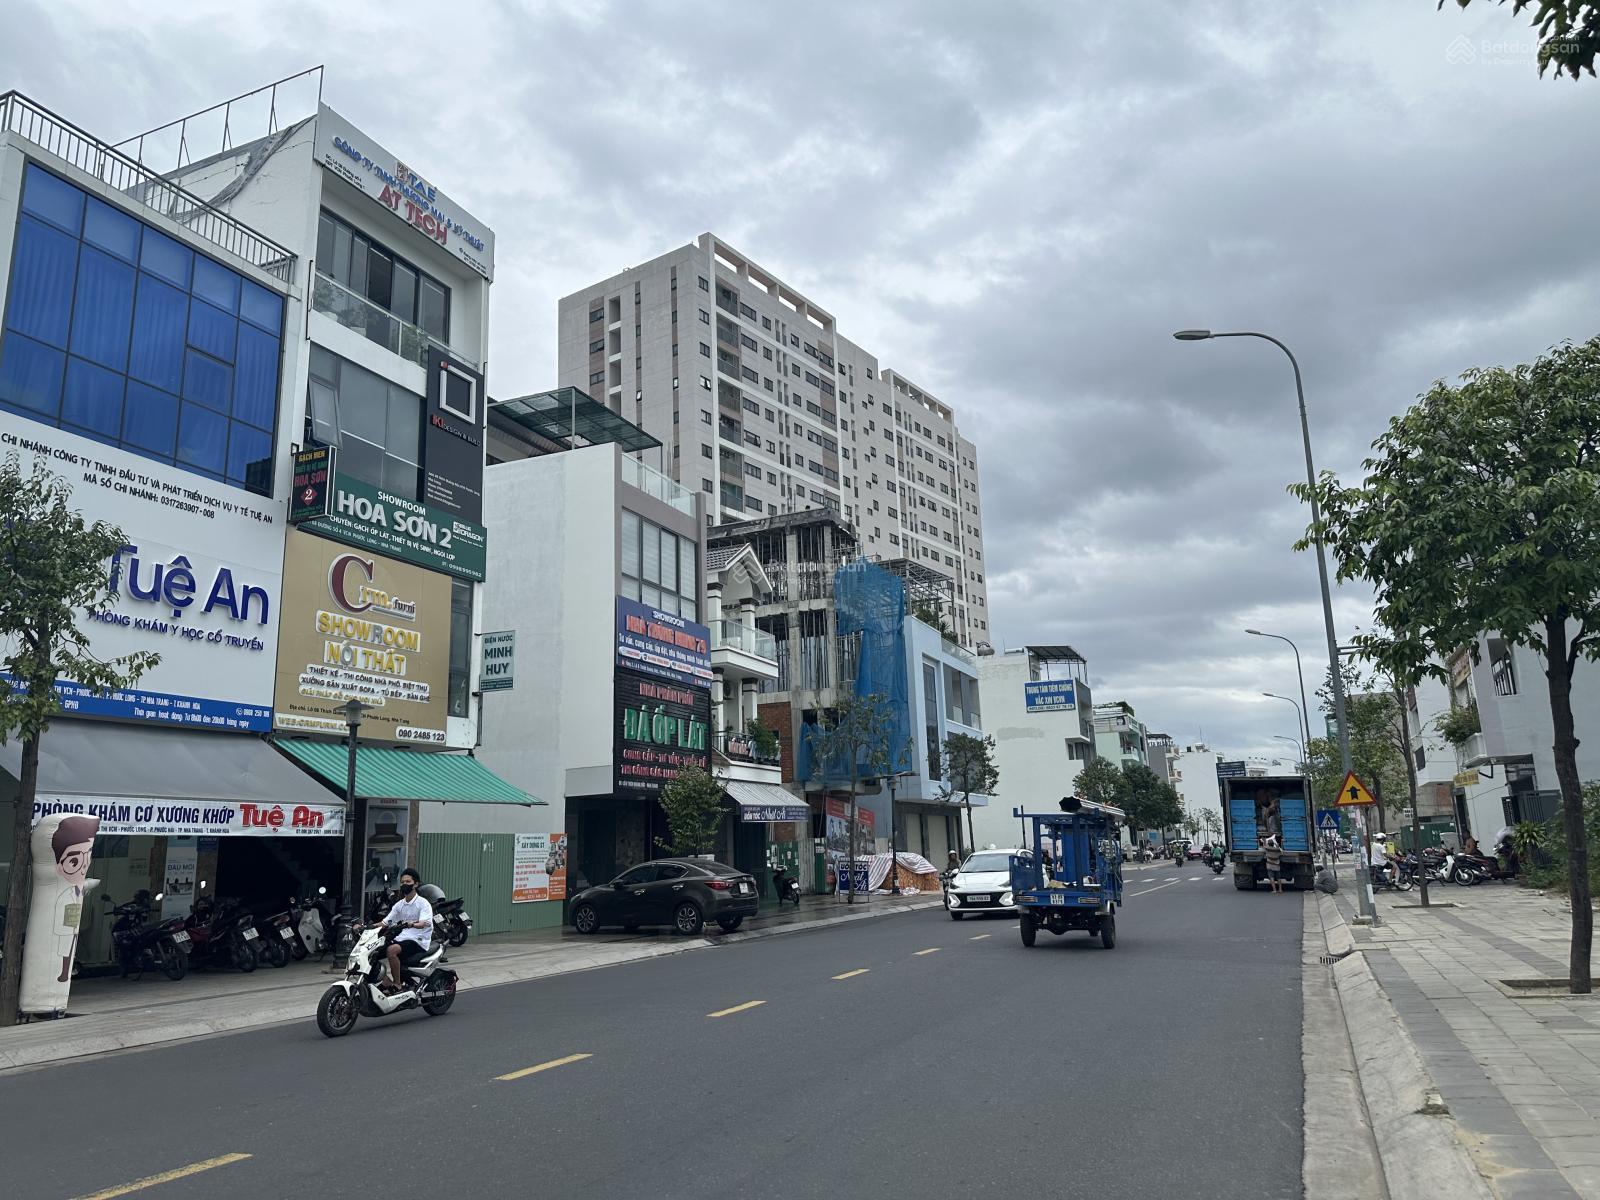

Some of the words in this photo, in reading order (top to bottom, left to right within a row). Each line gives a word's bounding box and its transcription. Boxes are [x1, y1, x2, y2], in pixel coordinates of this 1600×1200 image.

[379, 184, 401, 212] AT
[405, 200, 448, 246] TECH
[1, 433, 17, 445] CHI
[20, 439, 52, 456] NHÁNH
[54, 448, 78, 463] CÔNG
[81, 457, 91, 468] TY
[95, 461, 117, 476] TNHH
[119, 469, 136, 482] ĐẦU
[138, 475, 149, 485] TƯ
[151, 478, 160, 489] VÀ
[163, 483, 182, 495] PHÁT
[184, 489, 202, 502] TRIỂN
[204, 495, 221, 508] DỊCH
[223, 502, 232, 512] VỤ
[234, 505, 239, 513] Y
[241, 507, 248, 516] TẾ
[250, 510, 262, 521] TUỆ
[263, 515, 273, 524] AN
[84, 473, 97, 485] MÃ
[101, 477, 111, 488] SỐ
[114, 482, 127, 493] CHI
[130, 486, 158, 502] NHÁNH:
[304, 488, 313, 501] 2
[377, 491, 426, 516] SHOWROOM
[337, 490, 387, 527] HOA
[392, 510, 437, 544] SƠN
[439, 528, 452, 549] 2
[354, 523, 369, 535] GẠCH
[370, 525, 379, 535] ỐP
[109, 544, 197, 618] Tuệ
[202, 567, 270, 625] An
[134, 618, 168, 634] KHÁM
[171, 625, 179, 635] Y
[182, 626, 205, 642] HỌC
[207, 629, 223, 643] CỔ
[225, 634, 264, 651] TRUYỀN
[318, 611, 420, 652] SHOWROOM
[326, 641, 358, 669] NỘI
[362, 648, 406, 675] THẤT
[484, 646, 513, 659] MINH
[309, 666, 329, 676] THIẾT
[330, 668, 339, 677] KẾ
[355, 674, 373, 683] CÔNG
[374, 677, 387, 686] NHÀ
[486, 662, 510, 675] HUY
[301, 676, 325, 687] XƯỞNG
[341, 681, 358, 691] XUẤT
[359, 686, 376, 694] SOFA
[398, 729, 411, 738] 090
[413, 731, 431, 741] 2485
[432, 733, 445, 742] 123
[624, 704, 651, 742] ĐÁ
[652, 704, 676, 745] ỐP
[677, 714, 707, 750] LÁT
[88, 801, 130, 822] KHÁM
[135, 804, 153, 822] CƠ
[157, 805, 199, 824] XƯƠNG
[202, 805, 235, 824] KHỚP
[240, 803, 285, 833] Tuệ
[292, 805, 325, 829] An
